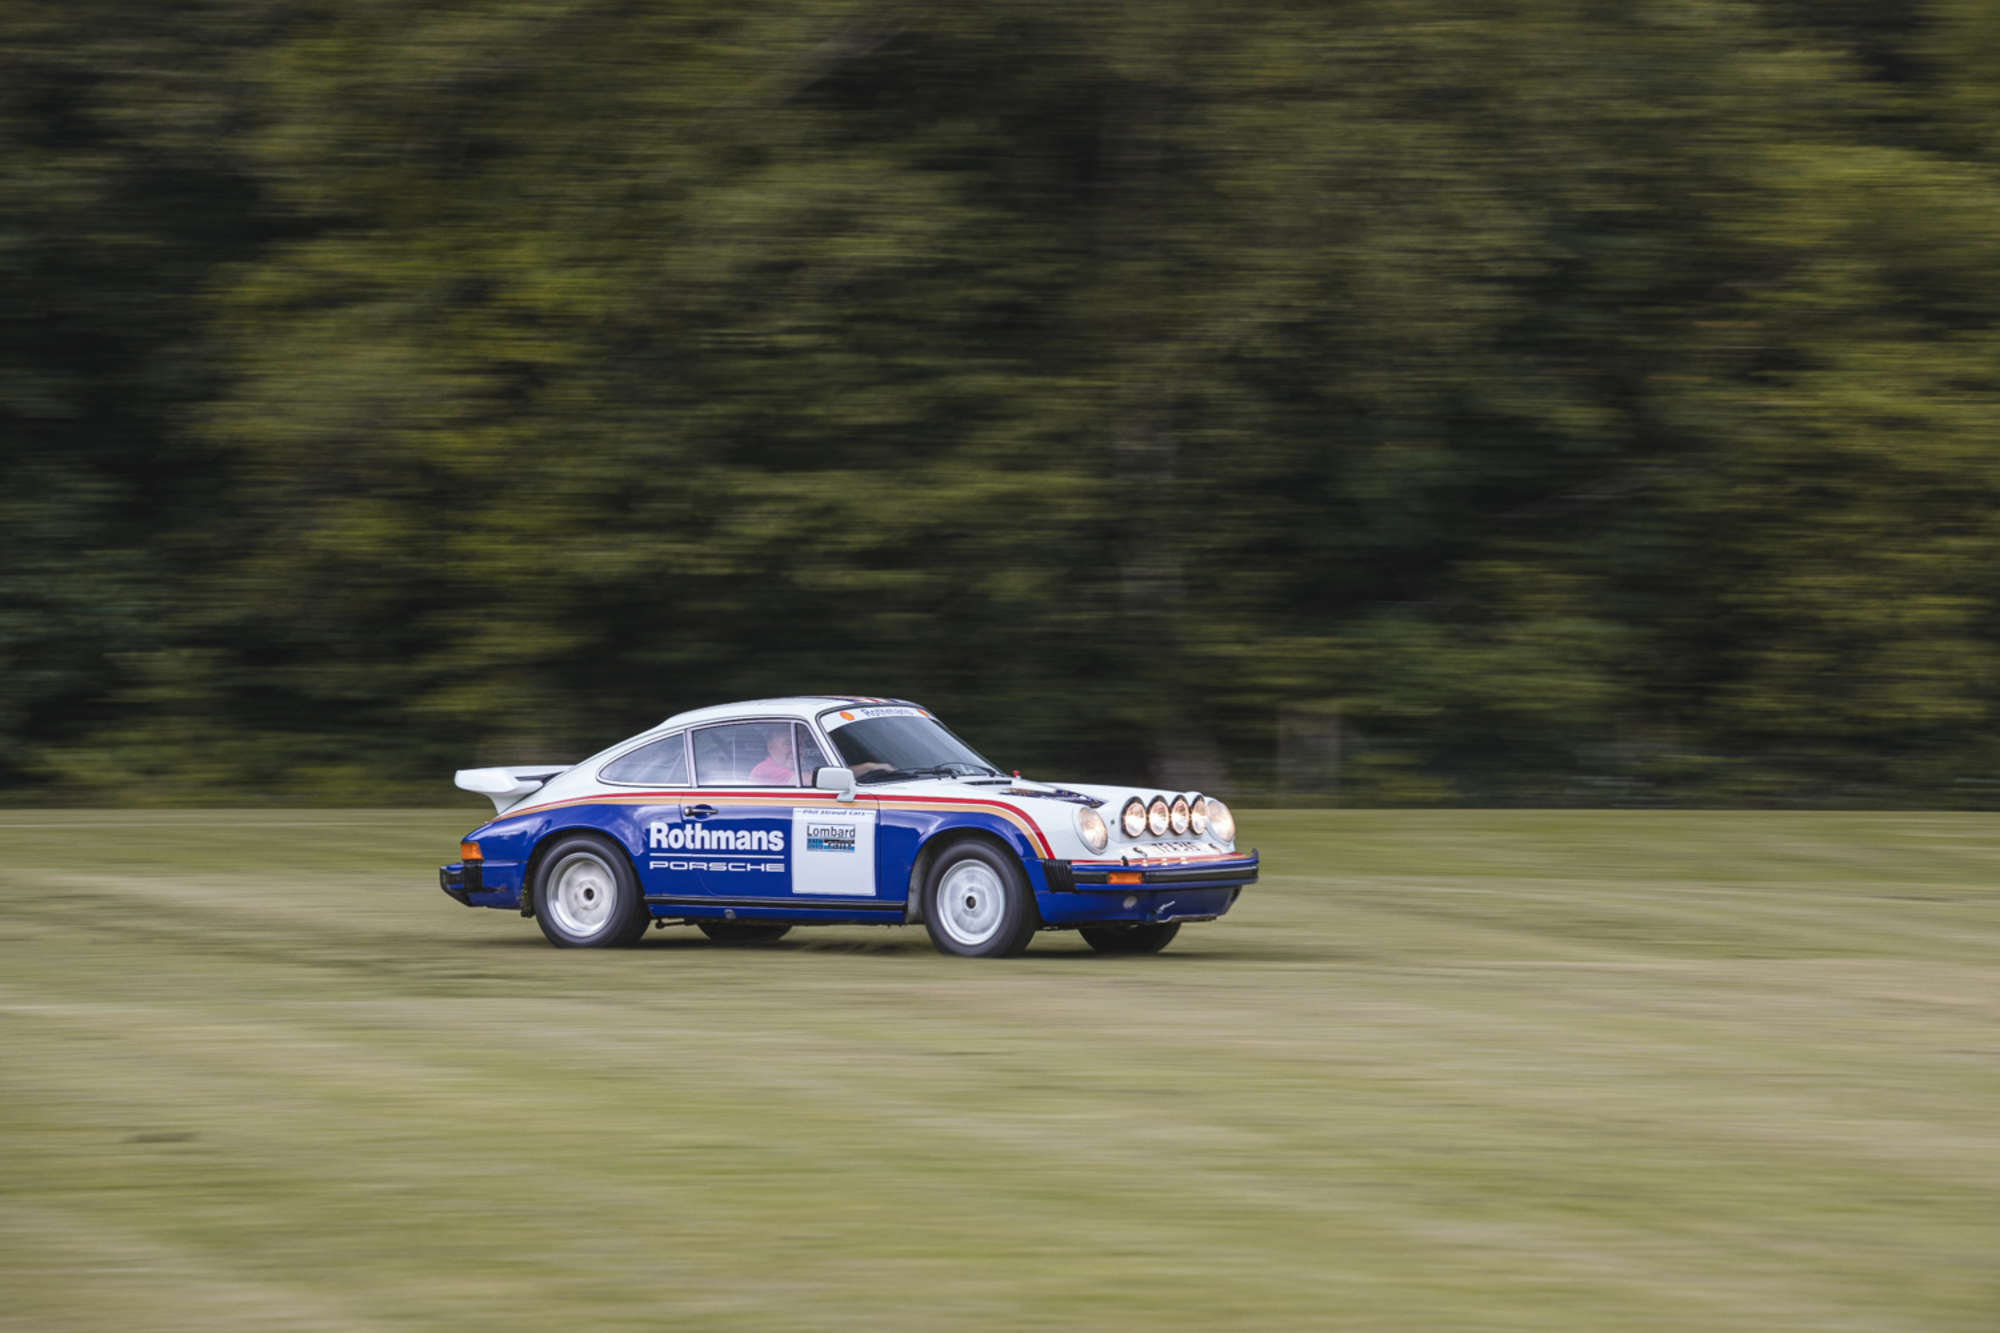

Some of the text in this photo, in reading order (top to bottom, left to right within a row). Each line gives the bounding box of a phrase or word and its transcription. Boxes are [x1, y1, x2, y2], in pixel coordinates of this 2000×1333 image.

[649, 822, 785, 851] Rothmans
[807, 825, 855, 838] Lombard
[649, 861, 785, 873] PORSCHE
